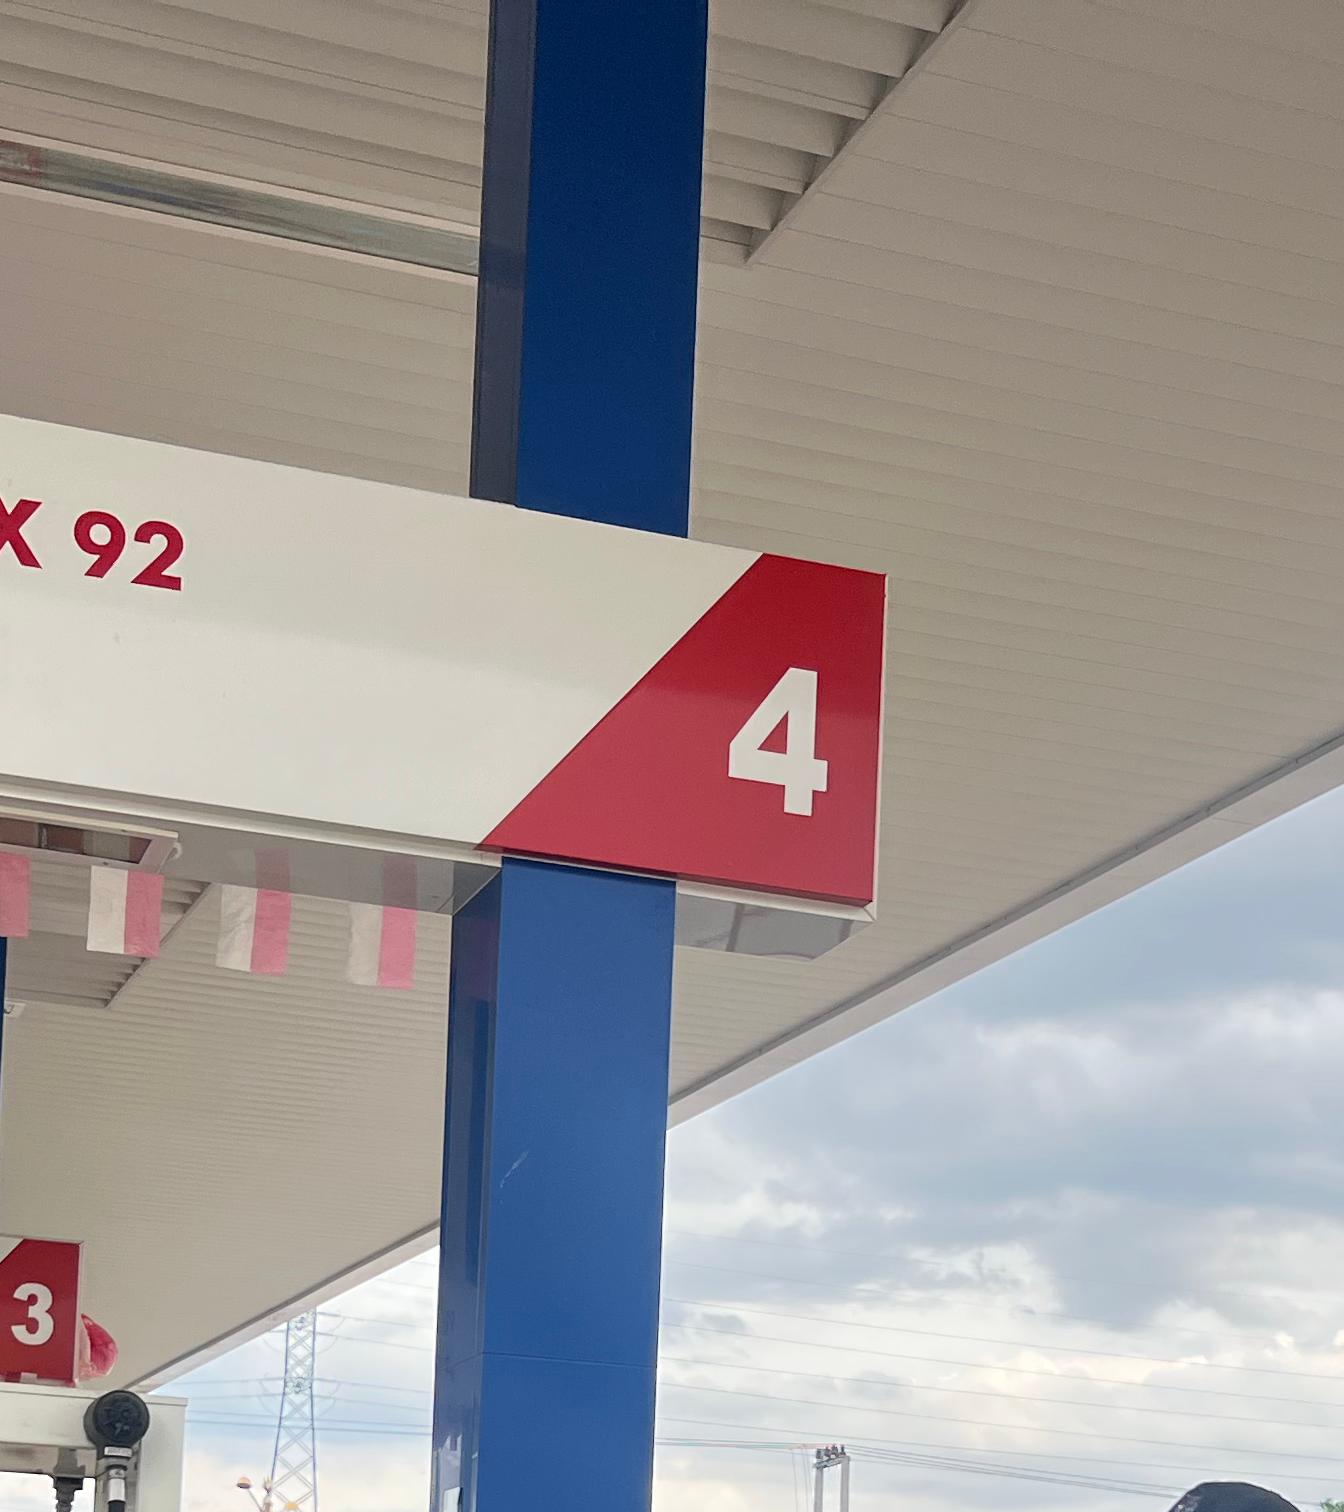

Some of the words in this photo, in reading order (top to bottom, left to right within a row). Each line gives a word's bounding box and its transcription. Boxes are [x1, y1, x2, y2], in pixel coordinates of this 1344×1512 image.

[72, 510, 185, 591] 92
[727, 667, 829, 816] 4
[11, 1283, 55, 1346] 3
